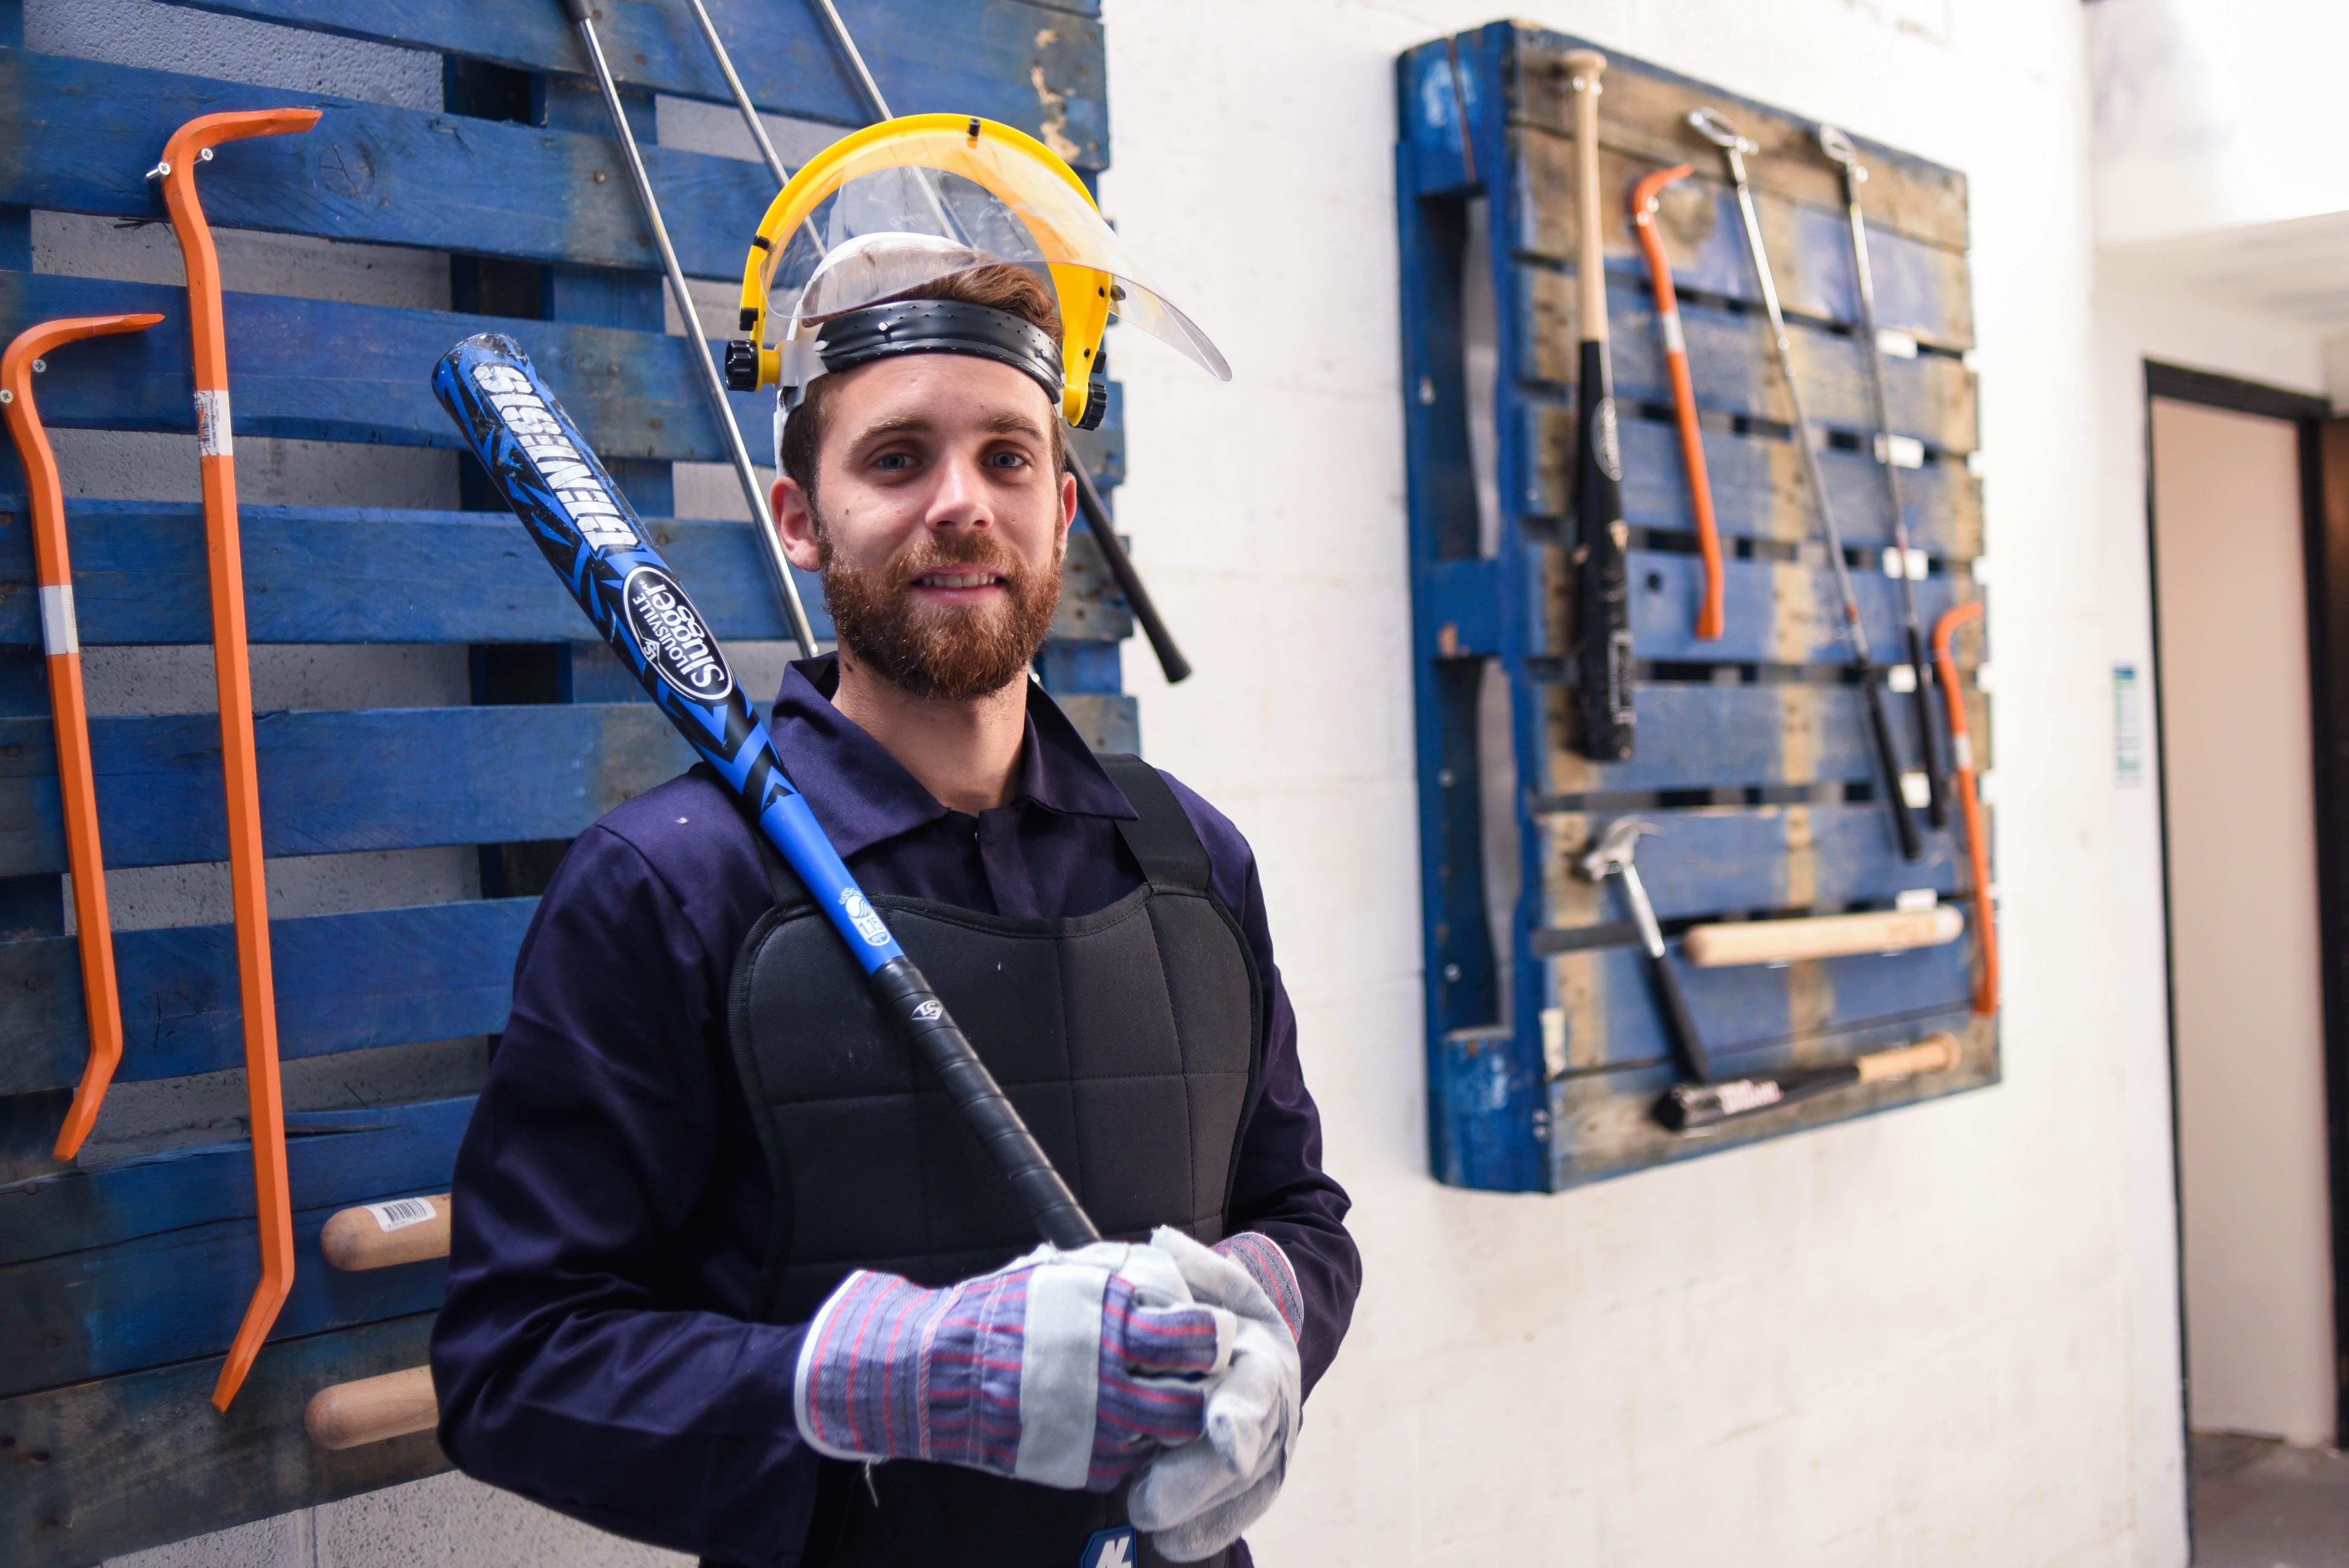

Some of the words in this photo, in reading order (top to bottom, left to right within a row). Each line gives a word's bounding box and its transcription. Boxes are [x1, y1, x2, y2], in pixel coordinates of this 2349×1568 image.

[473, 364, 638, 552] GENESIS
[632, 592, 689, 668] LOUISVILLE
[859, 917, 883, 935] 1.15
